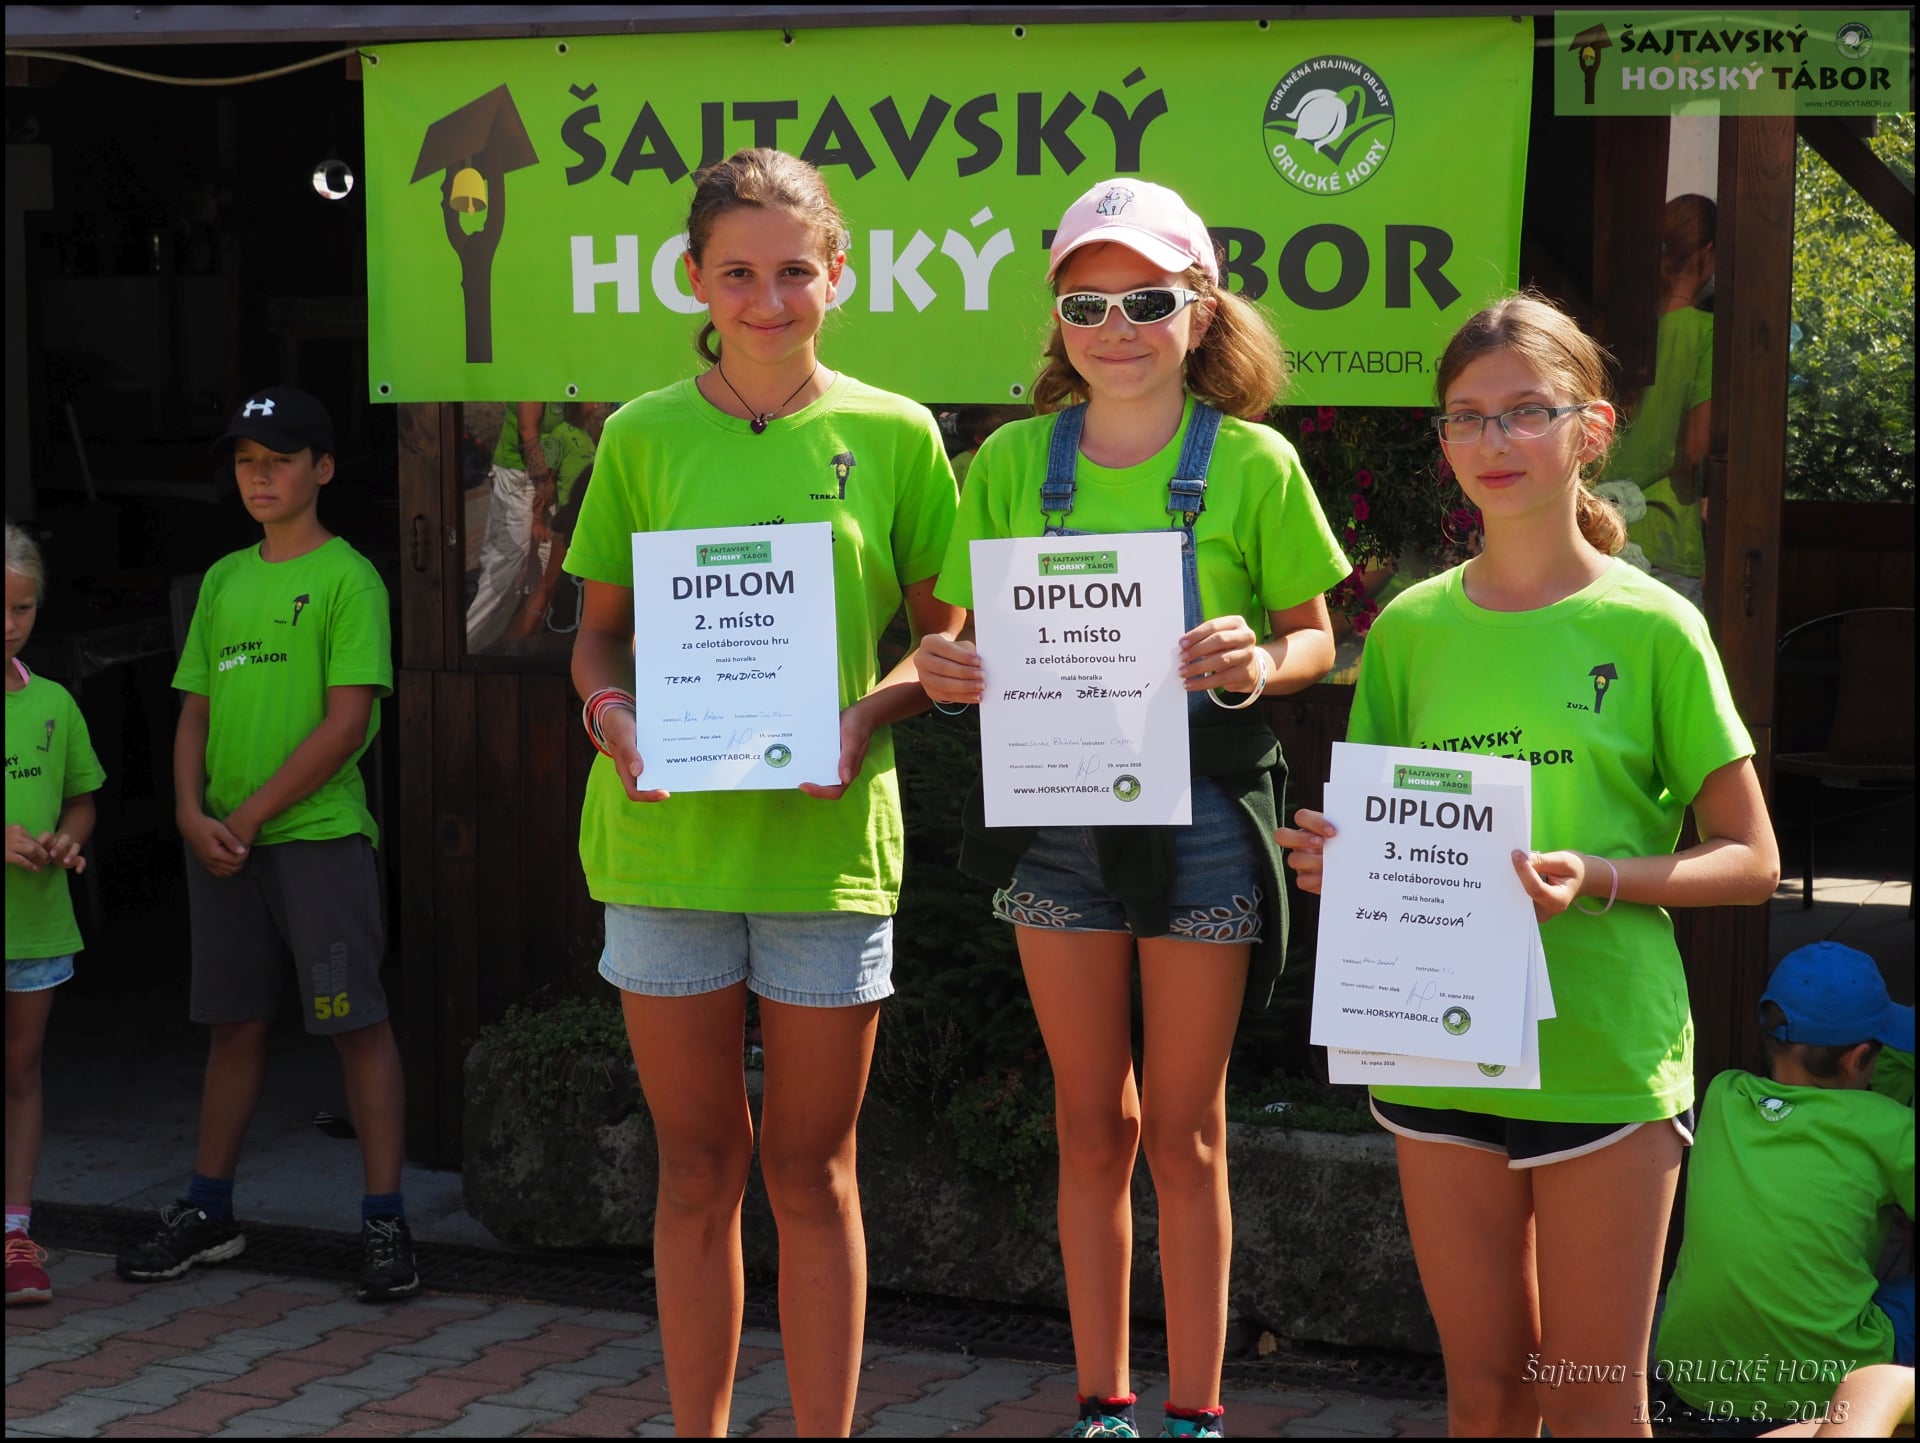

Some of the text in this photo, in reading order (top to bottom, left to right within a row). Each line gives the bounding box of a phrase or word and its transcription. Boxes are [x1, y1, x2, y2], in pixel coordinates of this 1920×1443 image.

[1270, 60, 1389, 111] CHRÁNĚNÁ KRAJINNÁ OBLAST
[1273, 138, 1386, 191] ORLICKÉ HORY
[672, 570, 795, 600] DIPLOM
[1013, 582, 1142, 611] DIPLOM
[695, 611, 775, 630] 2. místo
[682, 636, 789, 650] za celotáborovou hru
[1038, 625, 1121, 644] 1. místo
[732, 655, 757, 663] horalka
[1025, 653, 1137, 665] za celotáborovou hru
[664, 675, 702, 686] TERKA
[1003, 686, 1062, 701] HERMÍNKA
[666, 752, 761, 764] www.HORSKYTABOR.cz
[1013, 785, 1110, 795] www.HORSKYTABOR.cz
[1365, 795, 1494, 832] DIPLOM
[1384, 842, 1469, 866] 3. místo
[1368, 872, 1482, 889] za celotáborovou hru
[1402, 894, 1445, 904] malá horalka
[314, 992, 350, 1019] 56
[1342, 1007, 1439, 1023] www.HORSKYTABOR.cz
